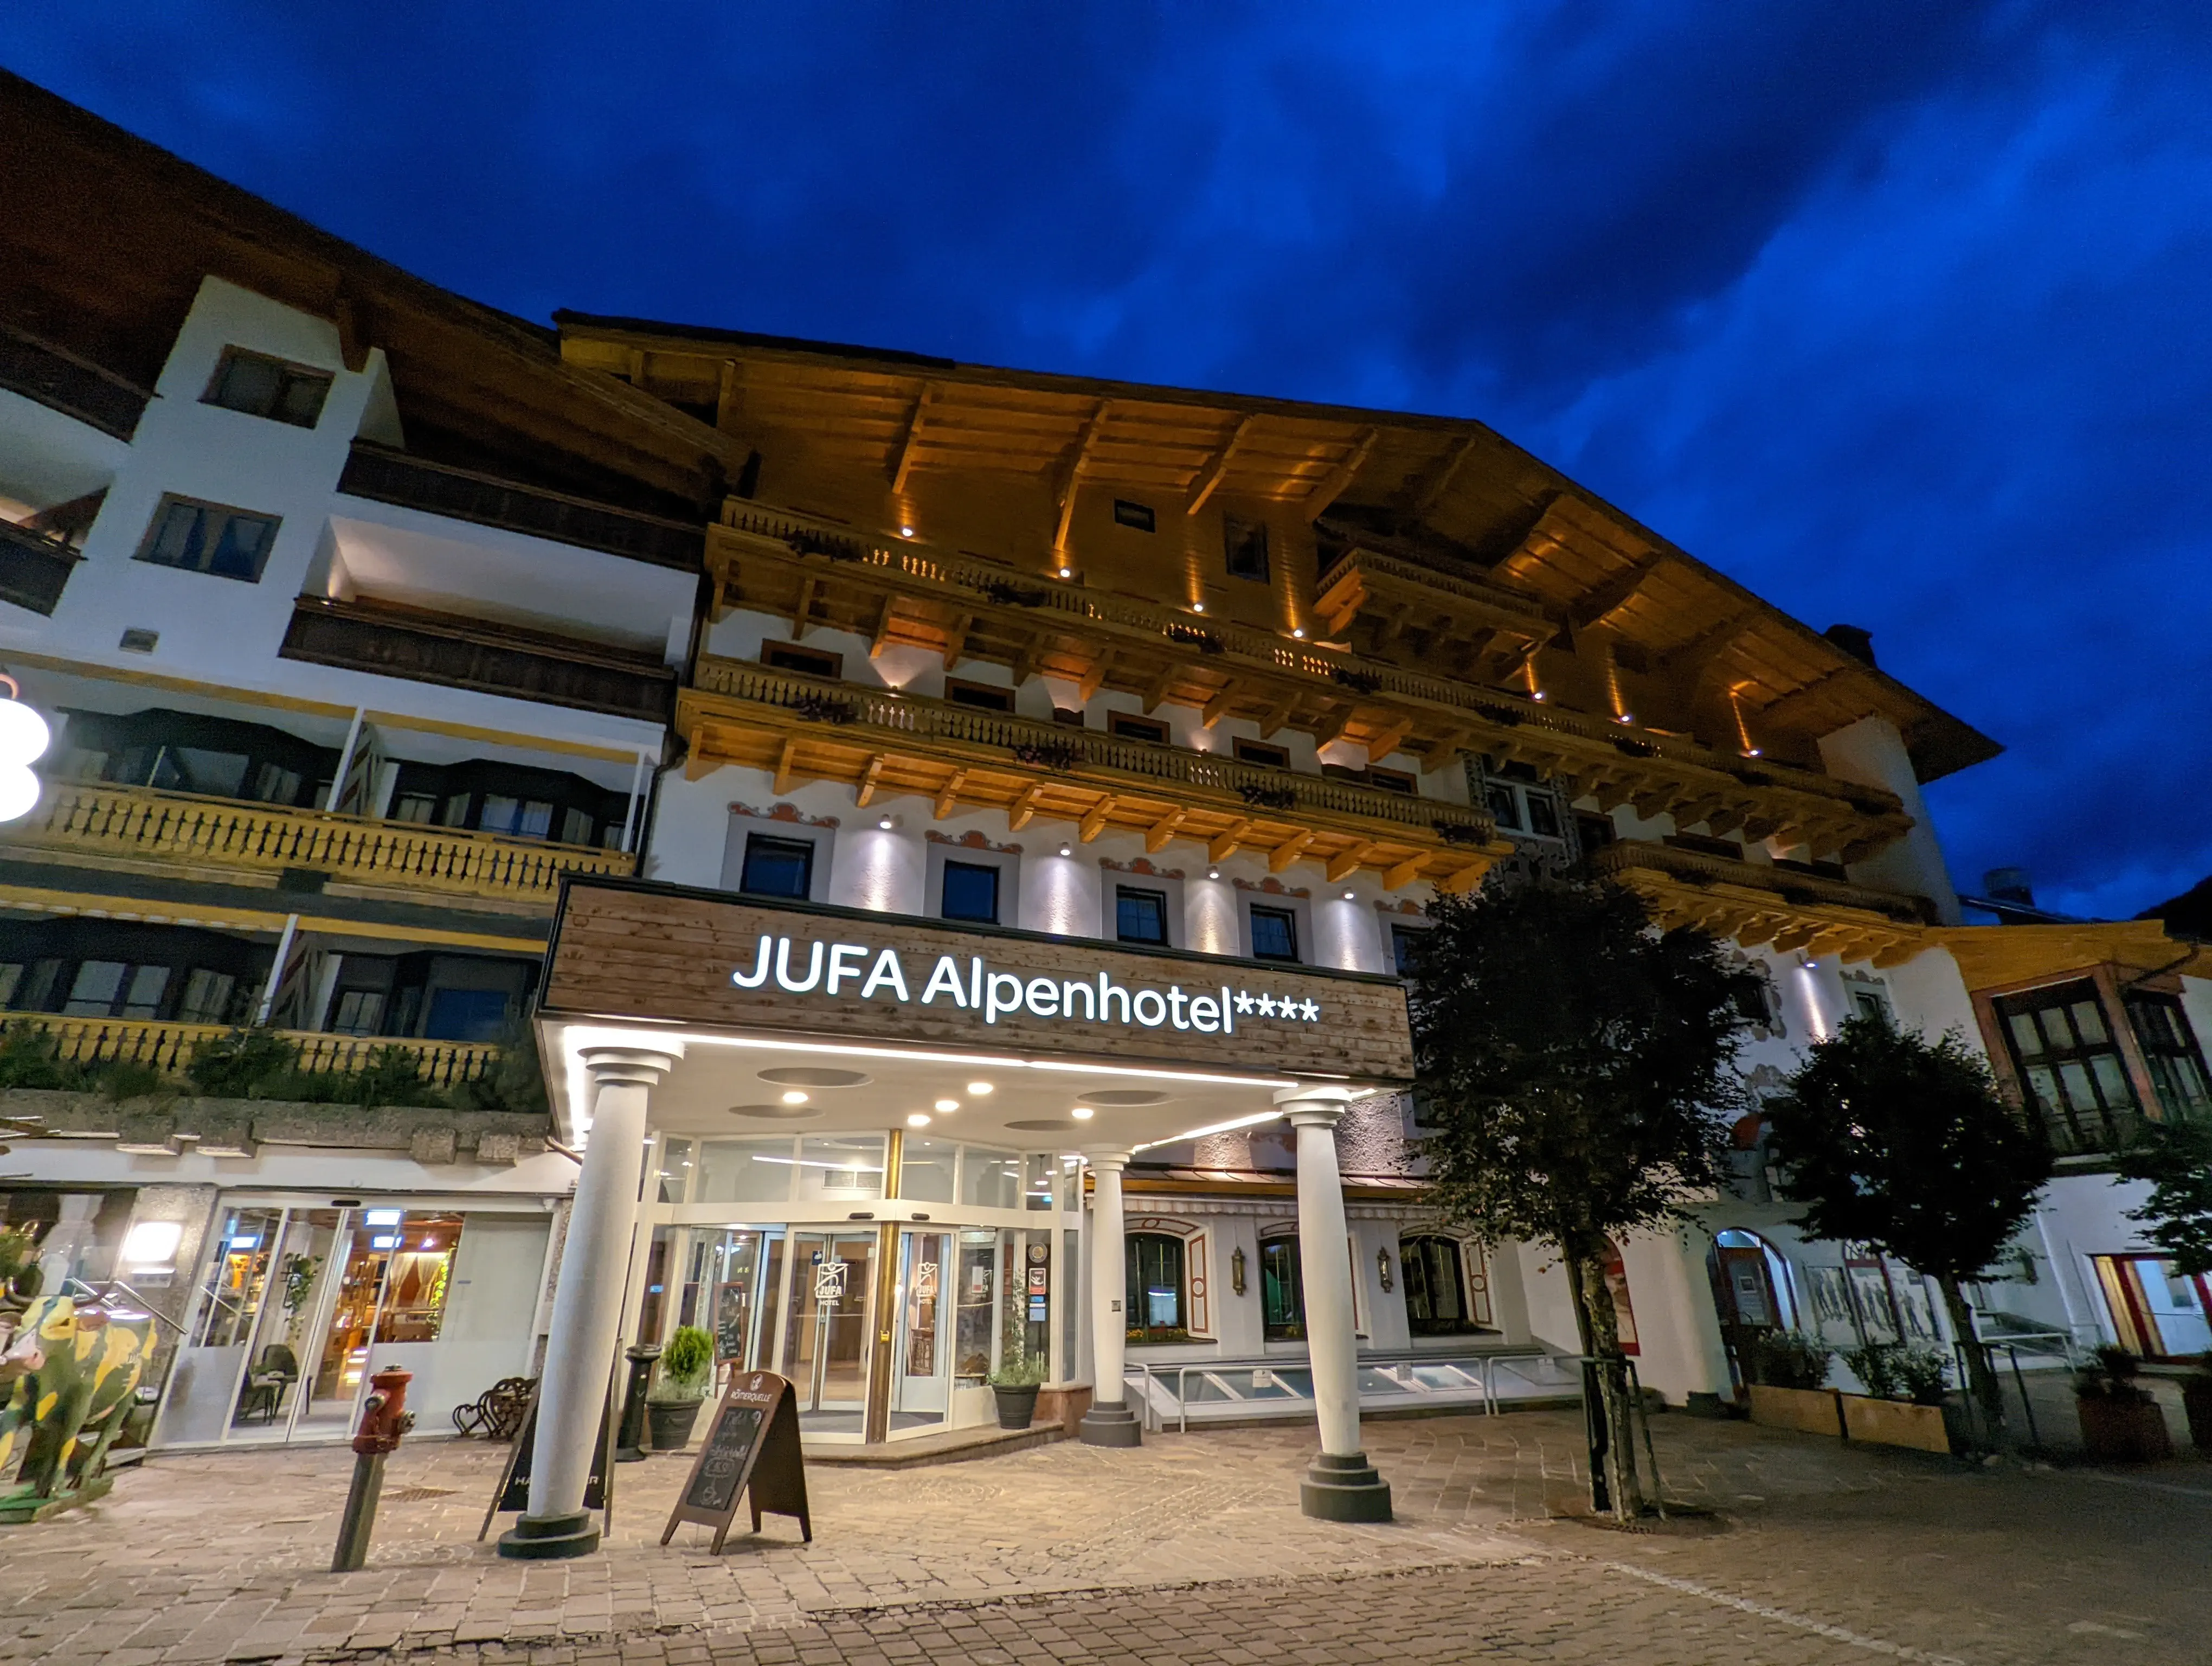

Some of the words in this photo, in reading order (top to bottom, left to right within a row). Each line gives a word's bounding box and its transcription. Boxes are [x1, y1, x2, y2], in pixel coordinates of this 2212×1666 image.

[732, 935, 909, 1002] JUFA
[819, 1285, 842, 1295] JUFA
[918, 1285, 934, 1294] JUFA
